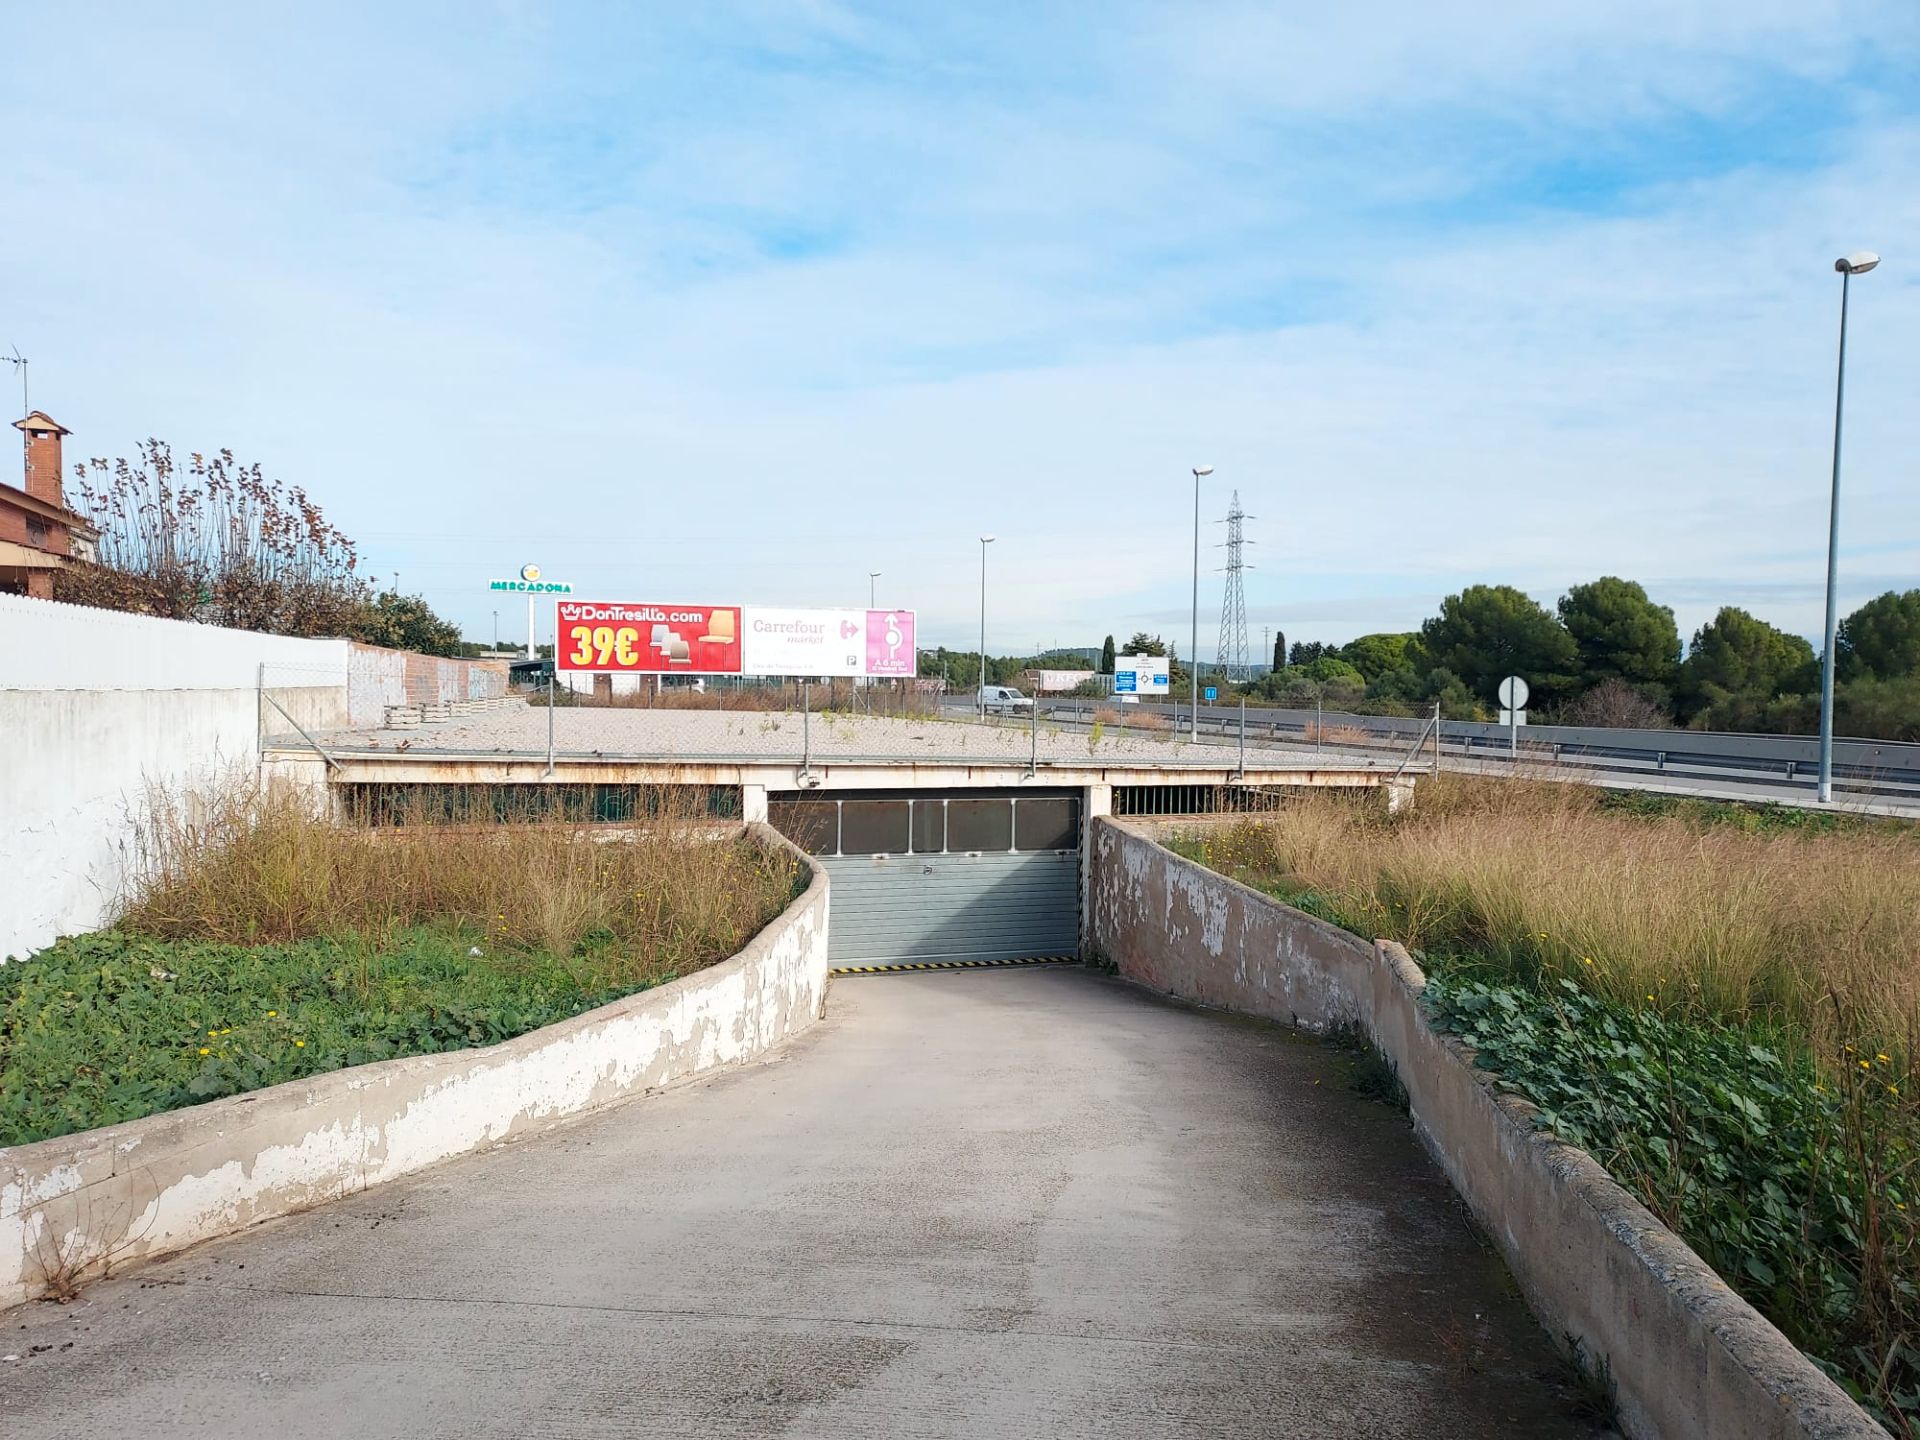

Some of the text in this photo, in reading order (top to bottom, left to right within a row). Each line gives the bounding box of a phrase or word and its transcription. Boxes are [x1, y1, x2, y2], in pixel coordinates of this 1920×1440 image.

[490, 581, 571, 592] MERCADONA
[582, 605, 702, 622] DonTresillo.com
[753, 620, 825, 634] Carrefour
[570, 626, 638, 666] 39€
[787, 635, 824, 645] market
